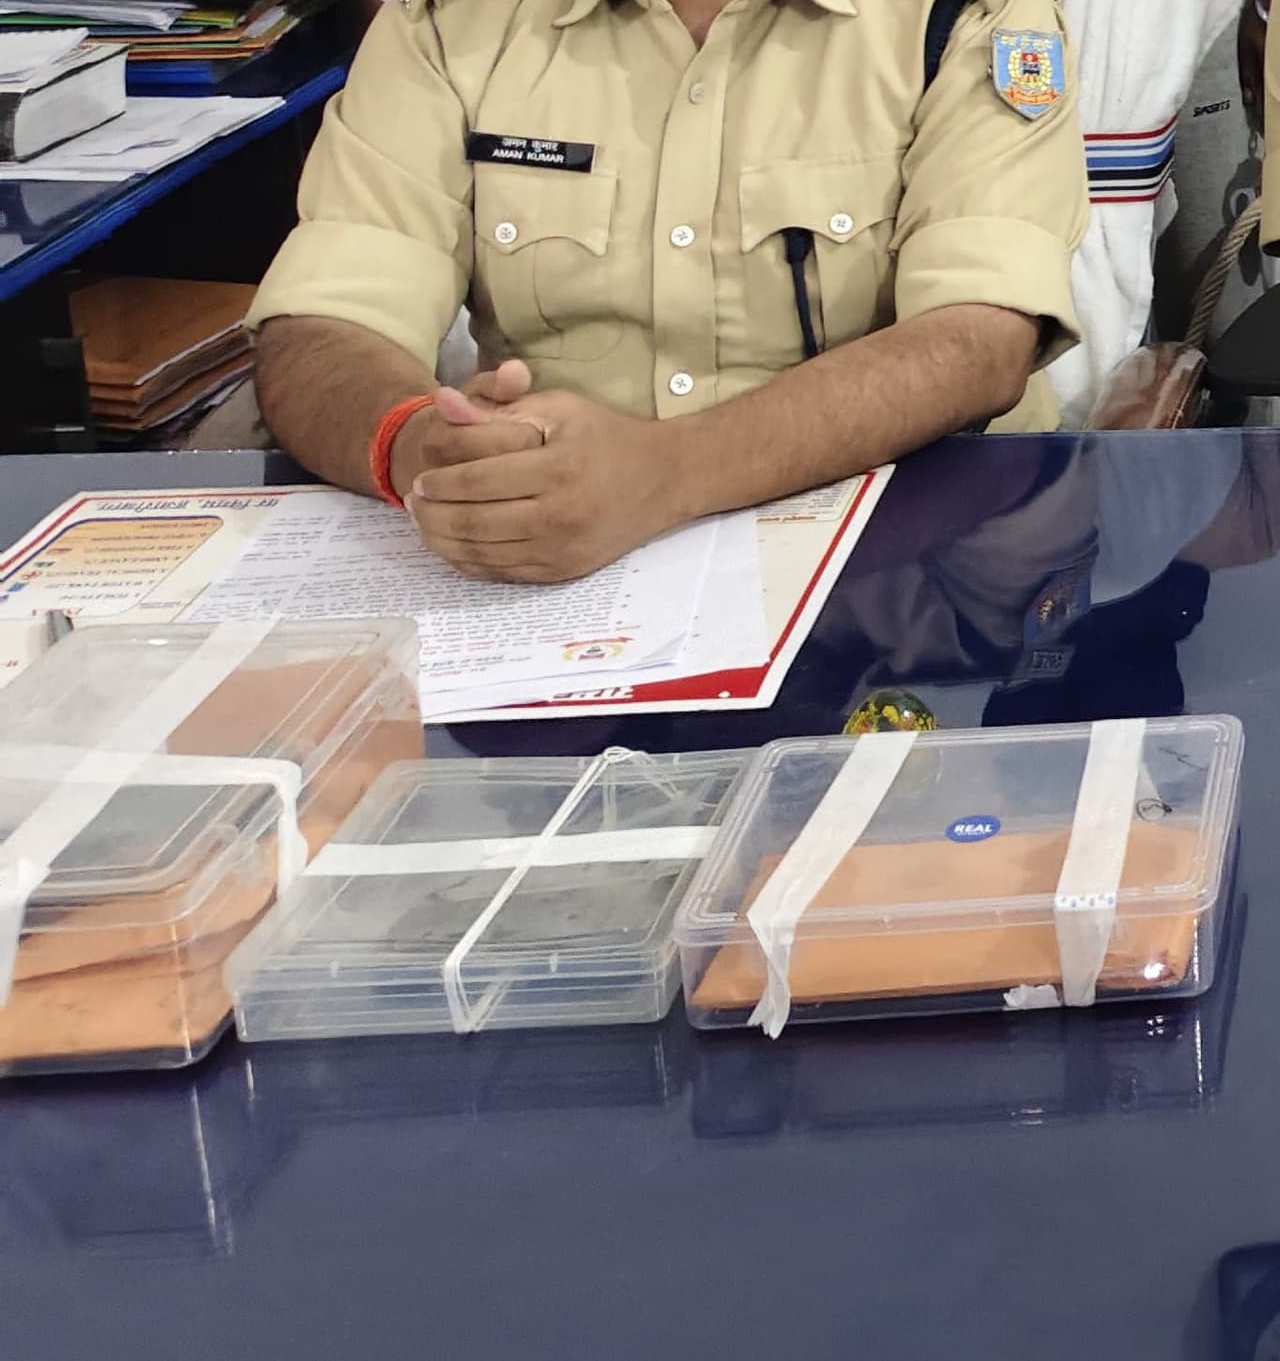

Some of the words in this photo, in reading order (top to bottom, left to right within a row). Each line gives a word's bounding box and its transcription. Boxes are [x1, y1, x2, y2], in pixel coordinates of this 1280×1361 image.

[491, 149, 522, 159] AMAN
[526, 152, 564, 163] KUMAR
[953, 823, 993, 835] REAL
